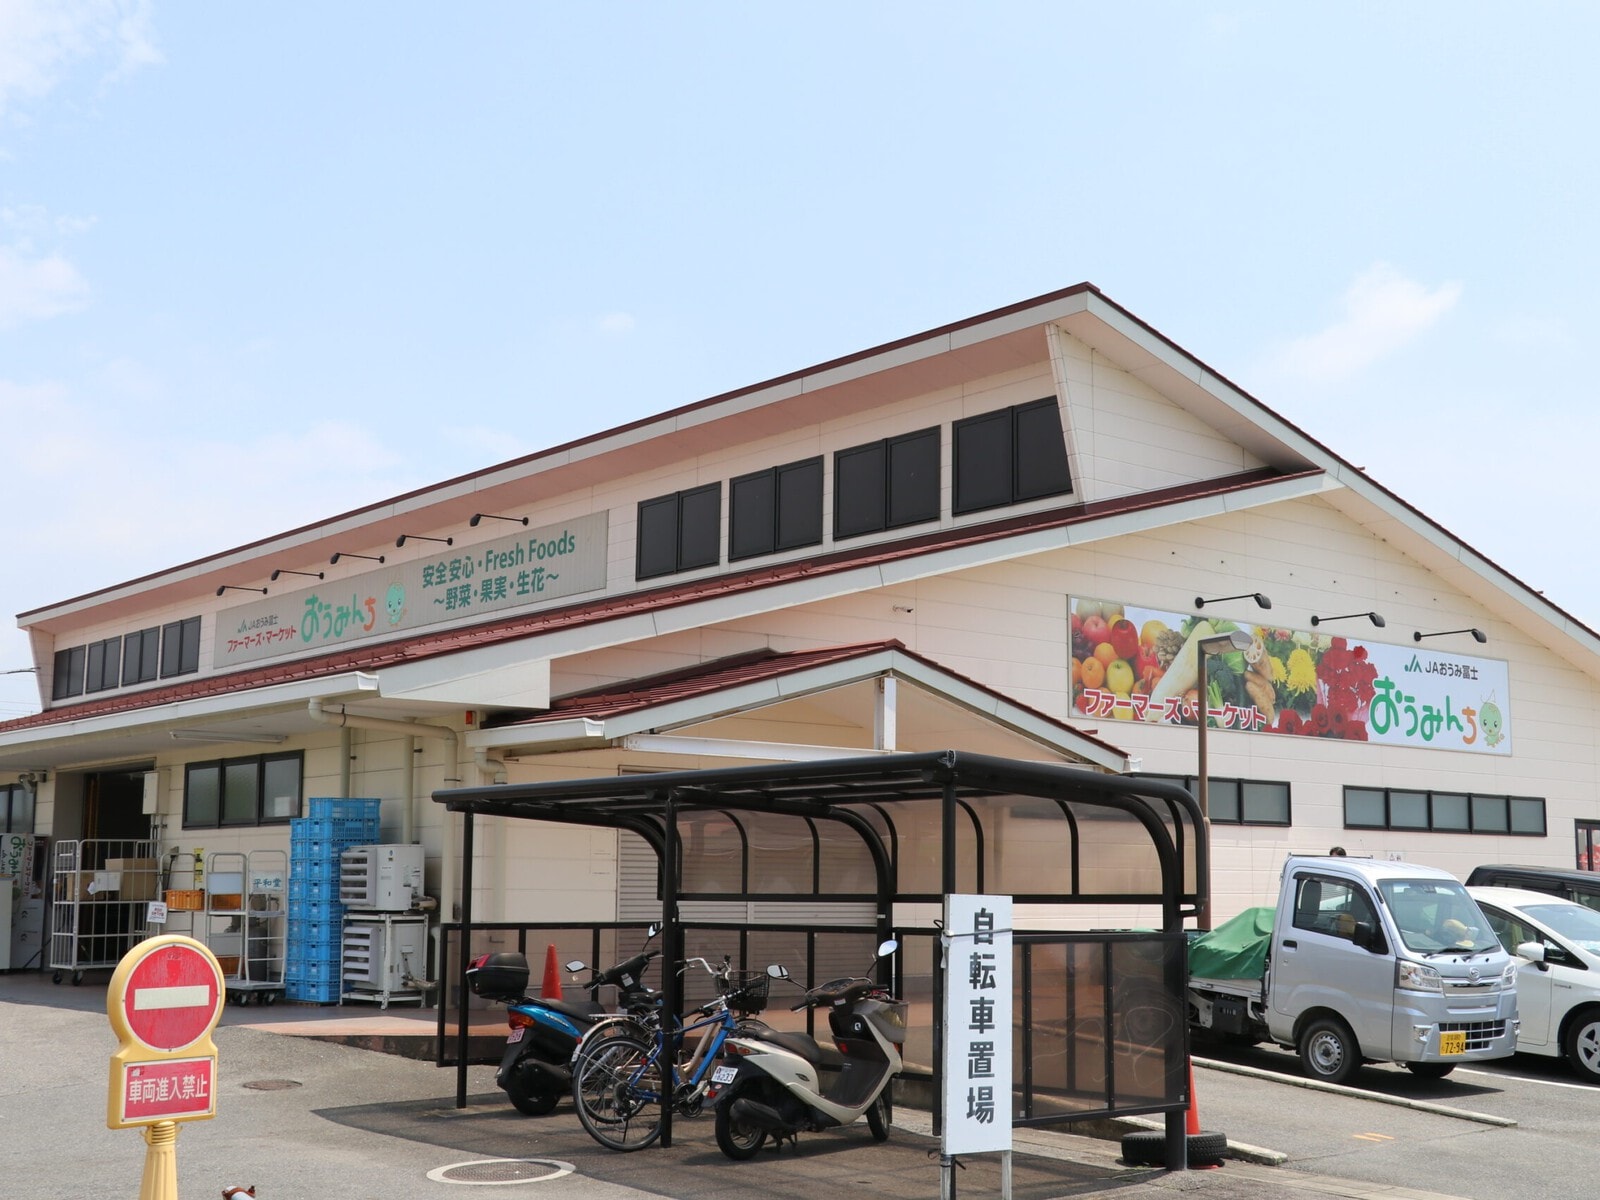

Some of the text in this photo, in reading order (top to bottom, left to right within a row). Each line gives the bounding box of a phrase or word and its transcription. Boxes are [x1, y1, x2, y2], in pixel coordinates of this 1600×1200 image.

[529, 530, 575, 562] Foods
[301, 593, 377, 643] おうみんち
[227, 625, 297, 653] ファーマーズ・マーケット
[1370, 675, 1477, 745] おうみんち
[252, 877, 282, 889] 平和堂
[966, 907, 997, 1124] 自転車置場
[128, 1073, 208, 1105] 車両進入禁止
